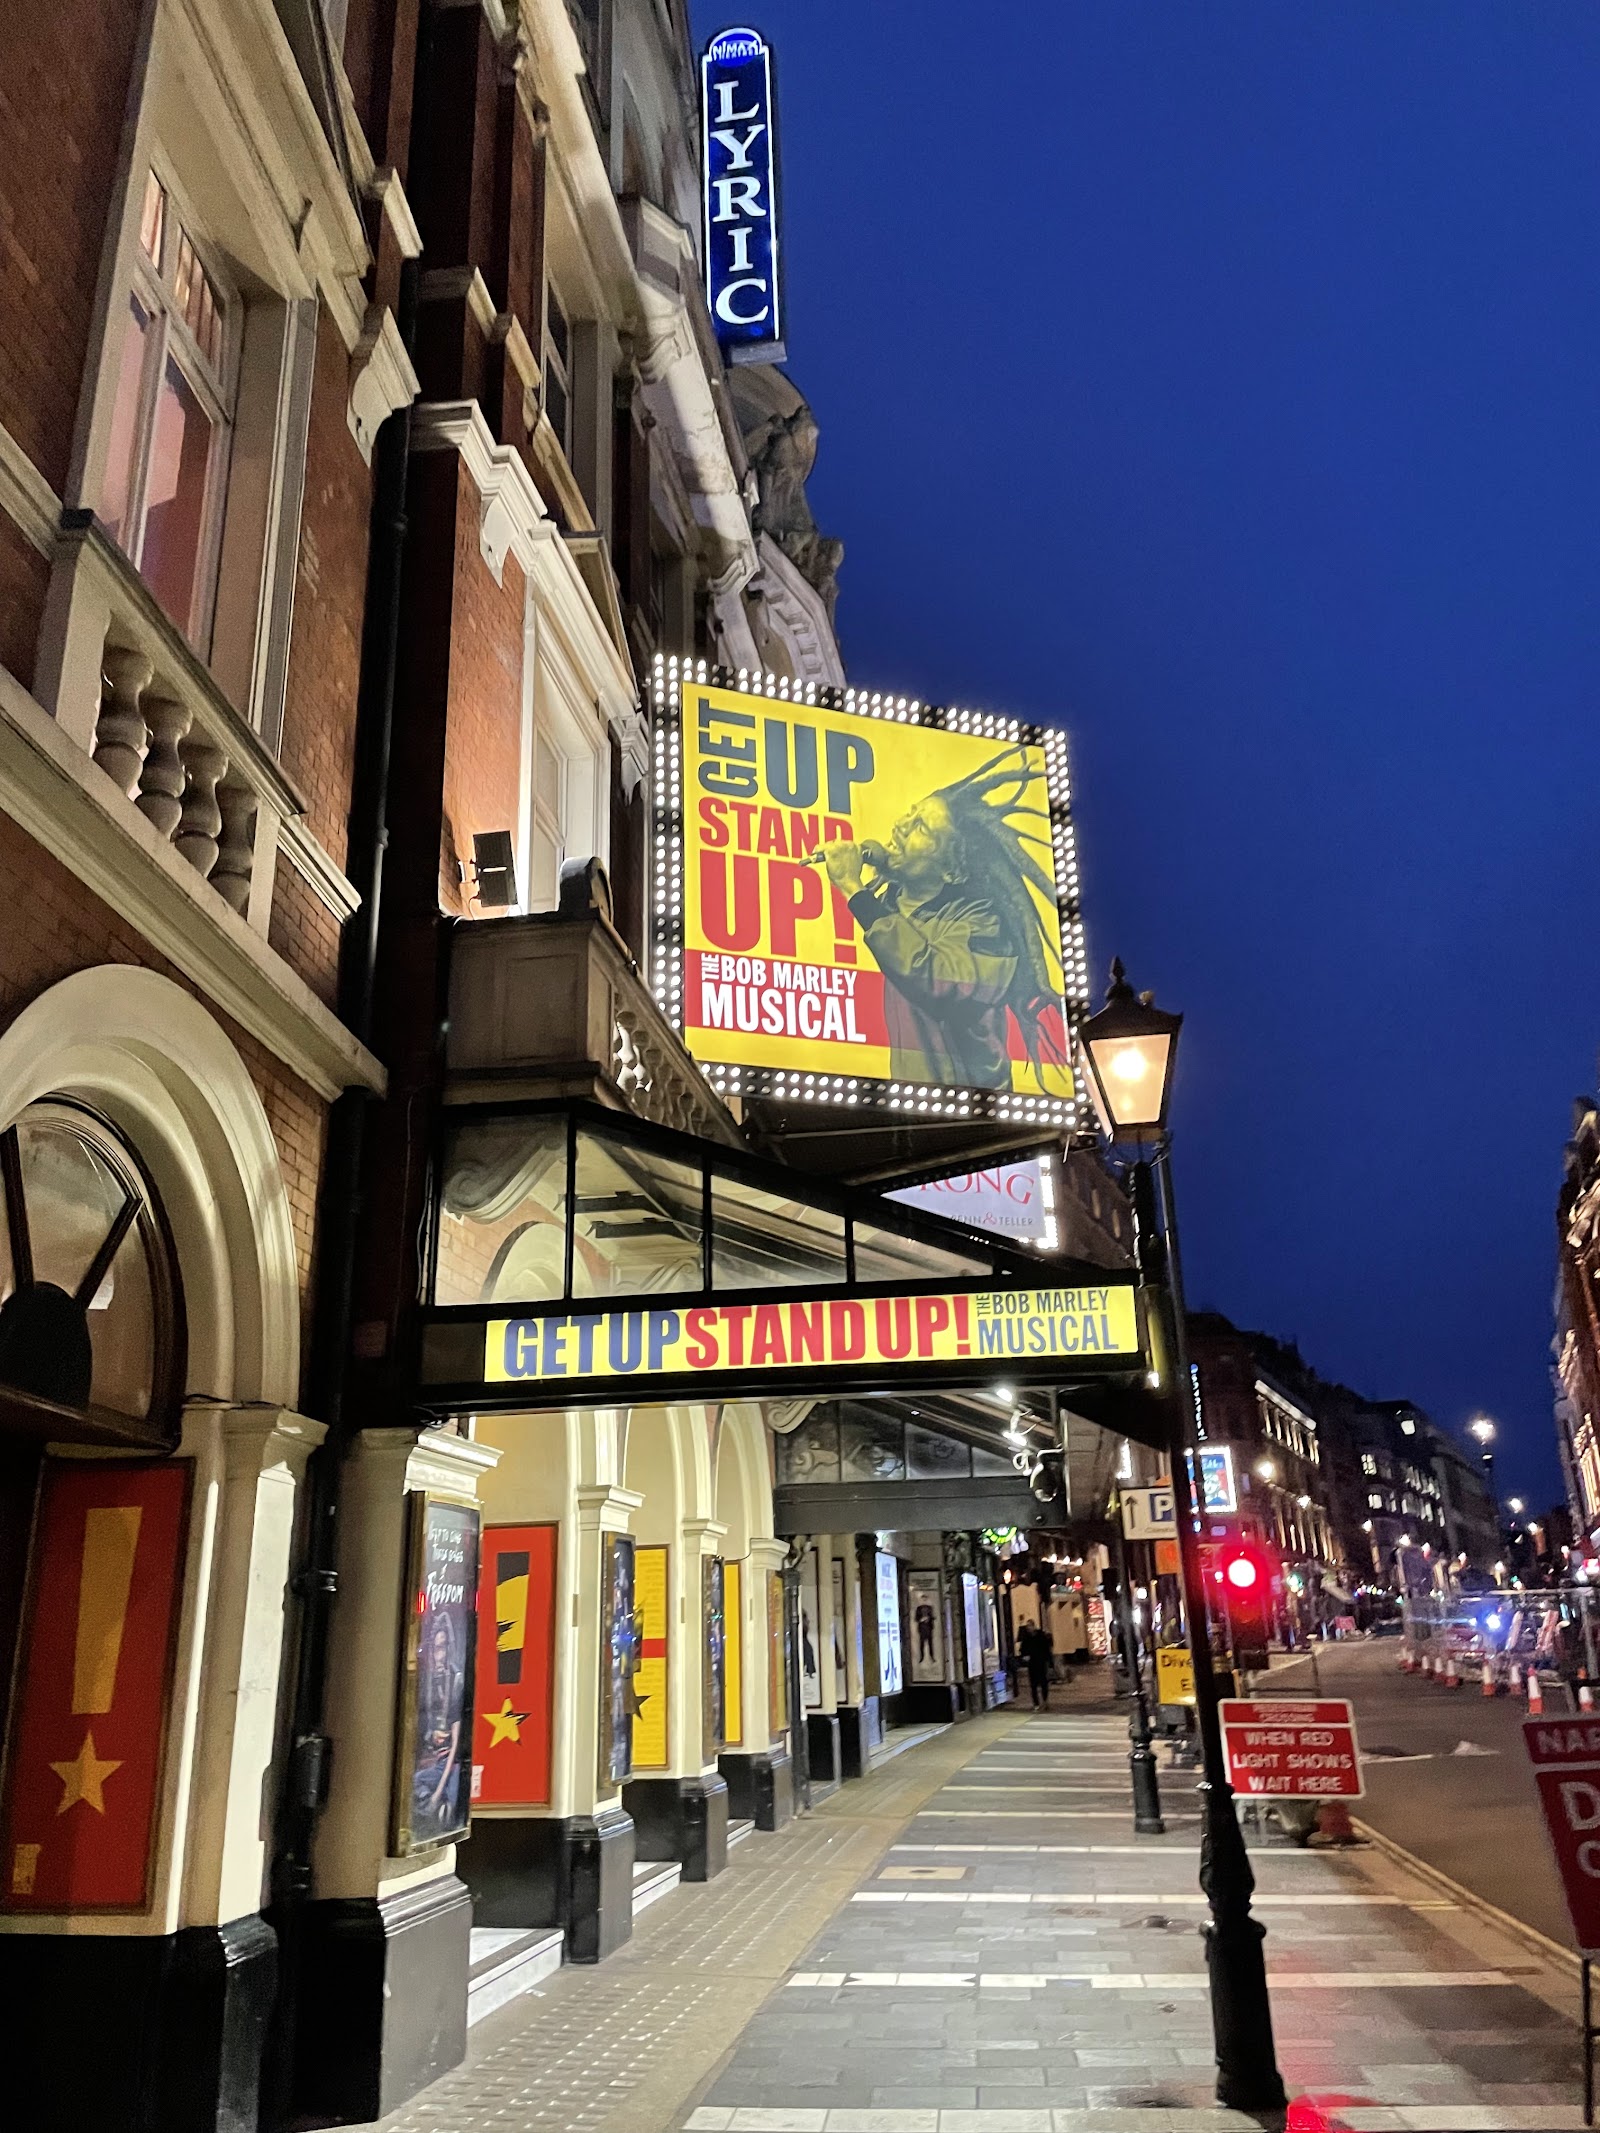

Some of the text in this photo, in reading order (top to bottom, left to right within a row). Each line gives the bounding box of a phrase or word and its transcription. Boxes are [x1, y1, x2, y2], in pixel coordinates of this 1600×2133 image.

[710, 80, 768, 324] LYRIC
[698, 696, 875, 816] GET UP
[700, 848, 858, 966] UP!
[701, 952, 858, 997] THE BOB MARLEY
[701, 981, 867, 1044] MUSICAL
[685, 1300, 866, 1369] STAND
[874, 1294, 971, 1361] UP!
[976, 1293, 991, 1317] THE
[992, 1293, 1030, 1315] BOB
[1036, 1288, 1110, 1314] MARLEY
[977, 1313, 1120, 1355] MUSICAL
[1154, 1494, 1174, 1520] P
[1232, 1752, 1353, 1769] LIGHT SHOWS
[1245, 1731, 1335, 1746] WHEN RED
[1248, 1776, 1343, 1792] WAIT HERE
